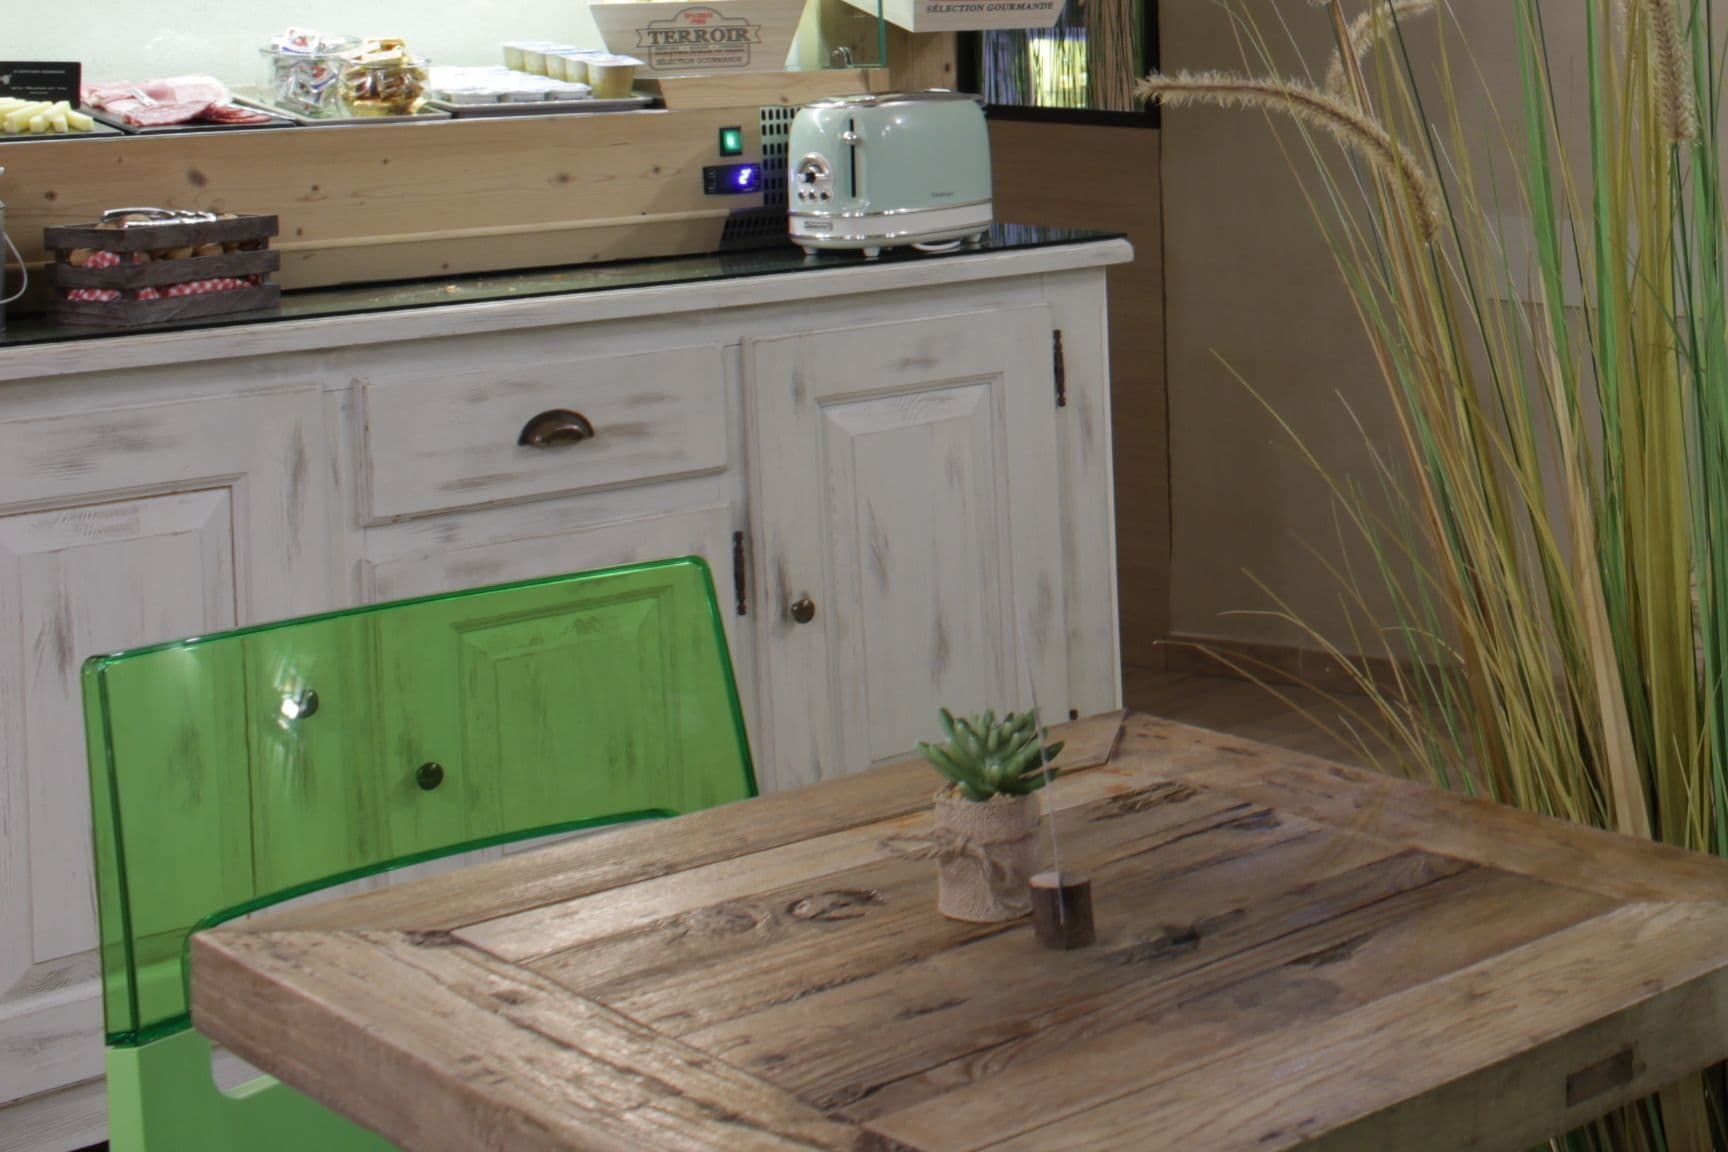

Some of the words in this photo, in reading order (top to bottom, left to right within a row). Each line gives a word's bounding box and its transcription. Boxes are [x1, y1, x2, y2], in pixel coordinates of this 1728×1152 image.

[926, 2, 985, 14] SÉLECTION
[986, 1, 1054, 12] GOURMANDE
[647, 28, 751, 45] TERROIR
